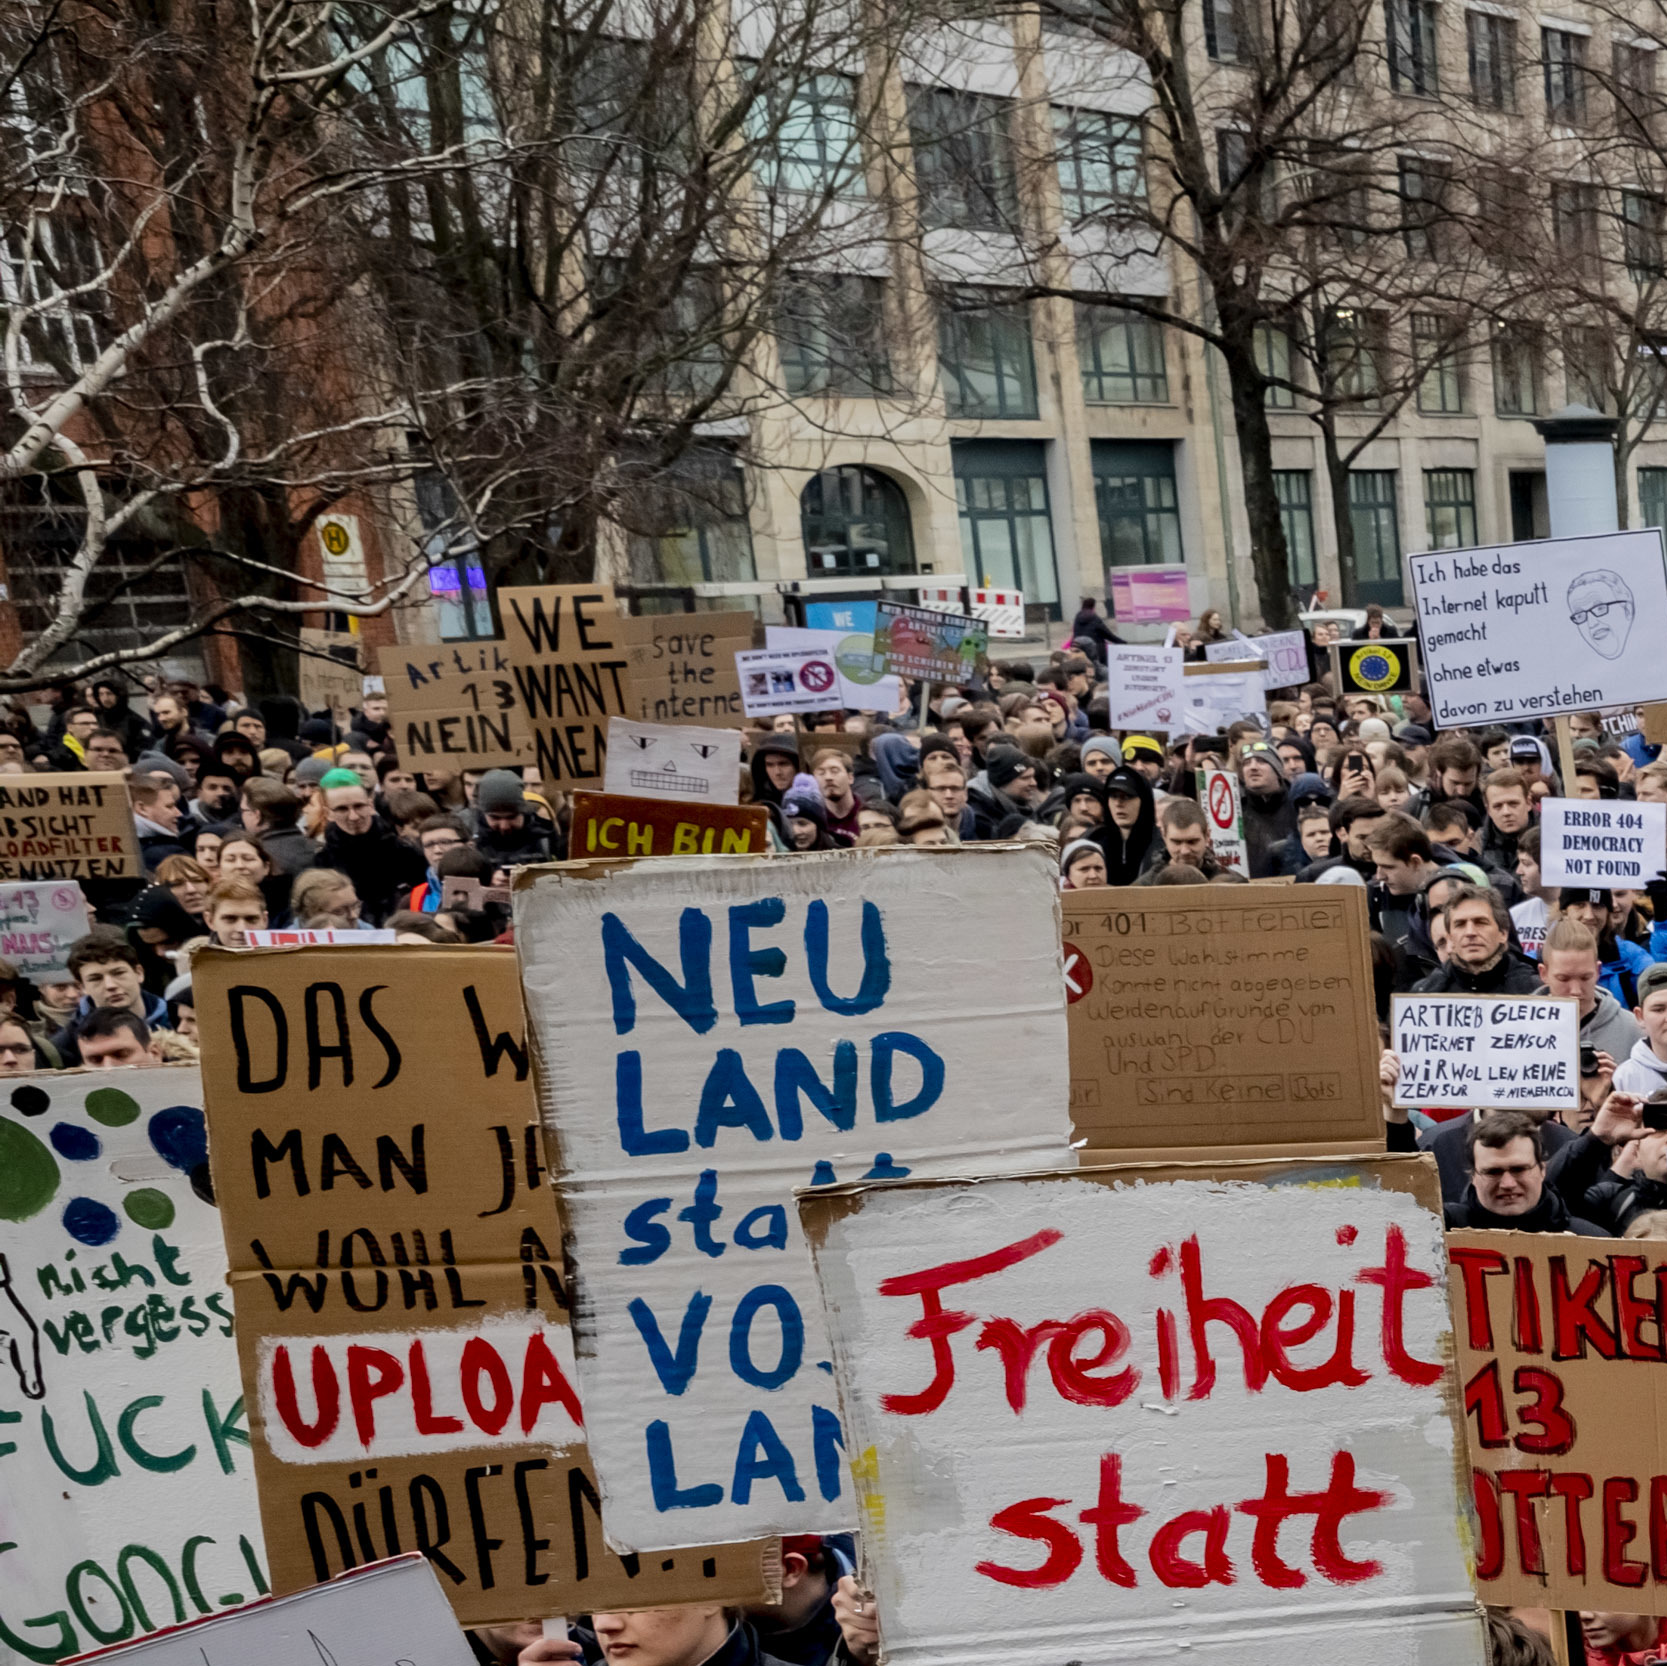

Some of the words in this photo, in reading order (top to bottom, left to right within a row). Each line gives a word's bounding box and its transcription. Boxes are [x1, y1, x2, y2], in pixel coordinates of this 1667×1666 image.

[1417, 561, 1446, 584] Ich
[1453, 556, 1489, 580] habe
[1492, 553, 1521, 575] das
[1422, 591, 1489, 616] Internet
[1495, 580, 1550, 616] kaputt
[509, 594, 614, 655] WE
[832, 610, 855, 627] WE
[1427, 621, 1488, 652] gemacht
[667, 660, 717, 685] the
[1433, 662, 1473, 683] ohne
[1477, 657, 1521, 677] etwas
[514, 660, 629, 720] WANT
[1439, 698, 1488, 720] davon
[1494, 698, 1515, 713] zu
[1519, 684, 1604, 710] verstehen
[61, 785, 107, 808] HAT
[1564, 810, 1612, 828] ERROR
[1616, 813, 1644, 829] 404
[586, 816, 654, 856] ICH
[672, 821, 752, 856] BIN
[1562, 833, 1645, 854] DEMOCRACY
[1565, 858, 1592, 875] NOT
[1597, 859, 1641, 877] FOUND
[600, 897, 890, 1036] NEU
[1095, 944, 1157, 968] Diese
[1230, 974, 1351, 1001] abgegeben
[1298, 1002, 1337, 1017] von
[1490, 1003, 1561, 1025] GLEICH
[230, 982, 401, 1095] DAS
[1256, 1016, 1315, 1045] CDU
[1401, 1033, 1476, 1053] INTERNET
[1490, 1033, 1558, 1051] ZENSUR
[1522, 1061, 1567, 1081] KEINE
[616, 1031, 946, 1157] LAND
[1292, 1076, 1336, 1100] Bots
[1400, 1082, 1469, 1099] ZENSUR
[249, 1123, 427, 1199] MAN
[34, 1234, 191, 1300] nicht
[249, 1228, 487, 1315] WOHL
[878, 1222, 1446, 1416] Freiheit
[628, 1283, 834, 1399] VO
[271, 1330, 585, 1452] UPLOA
[1464, 1358, 1578, 1456] 13
[972, 1449, 1400, 1590] statt
